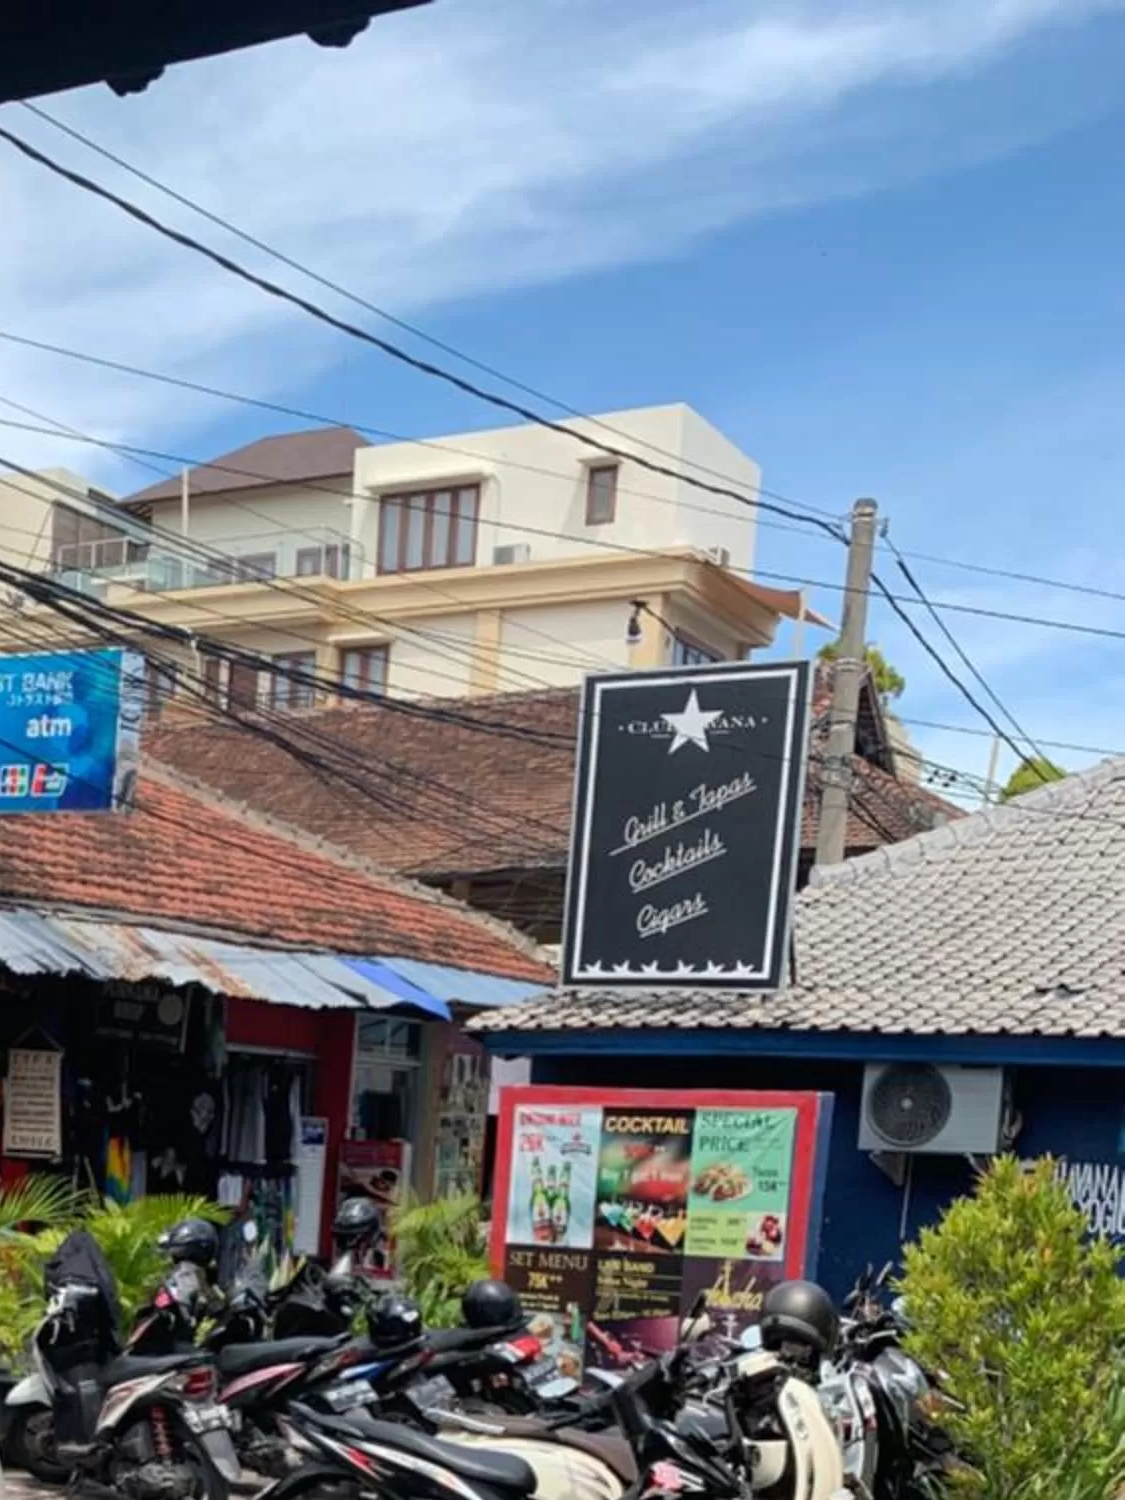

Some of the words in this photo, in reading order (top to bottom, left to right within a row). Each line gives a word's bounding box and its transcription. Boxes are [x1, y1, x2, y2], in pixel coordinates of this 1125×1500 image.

[21, 670, 74, 694] BANK
[26, 713, 73, 738] atm
[624, 802, 666, 846] Grill
[672, 799, 686, 824] &
[688, 771, 755, 812] Tapas
[628, 828, 724, 888] Cocktails
[636, 892, 707, 934] Cigars
[604, 1115, 691, 1135] COCKTAIL
[508, 1250, 534, 1268] SET
[537, 1252, 589, 1271] MENU
